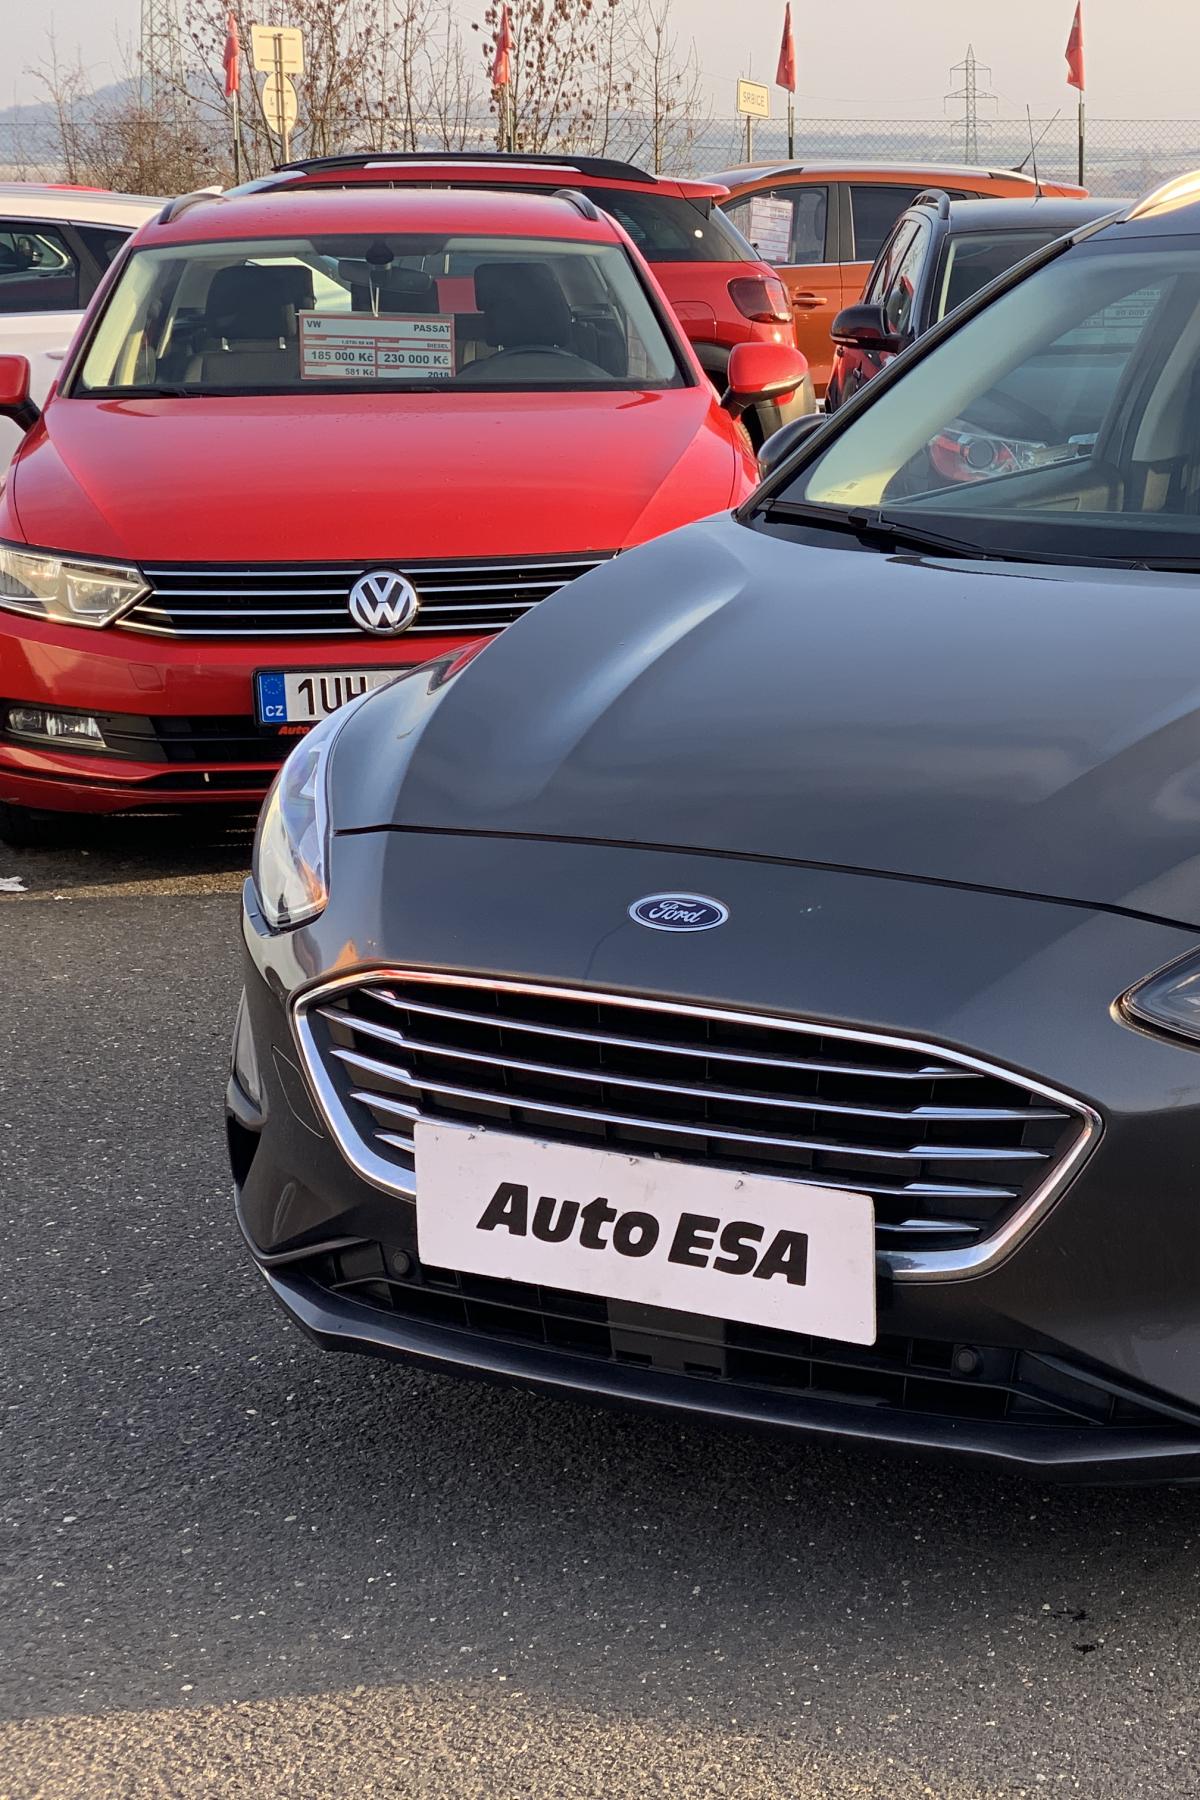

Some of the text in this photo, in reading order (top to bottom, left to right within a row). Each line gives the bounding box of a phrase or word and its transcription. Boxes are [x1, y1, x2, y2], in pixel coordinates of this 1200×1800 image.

[306, 320, 322, 328] VW
[413, 324, 450, 333] PASSAT
[311, 351, 374, 362] 185 000 Kč
[384, 353, 449, 365] 230 000 Kč
[345, 367, 360, 376] 581
[265, 705, 284, 717] CZ
[278, 726, 310, 736] Auto
[648, 900, 708, 923] Ford
[476, 1182, 809, 1287] Auto ESA
